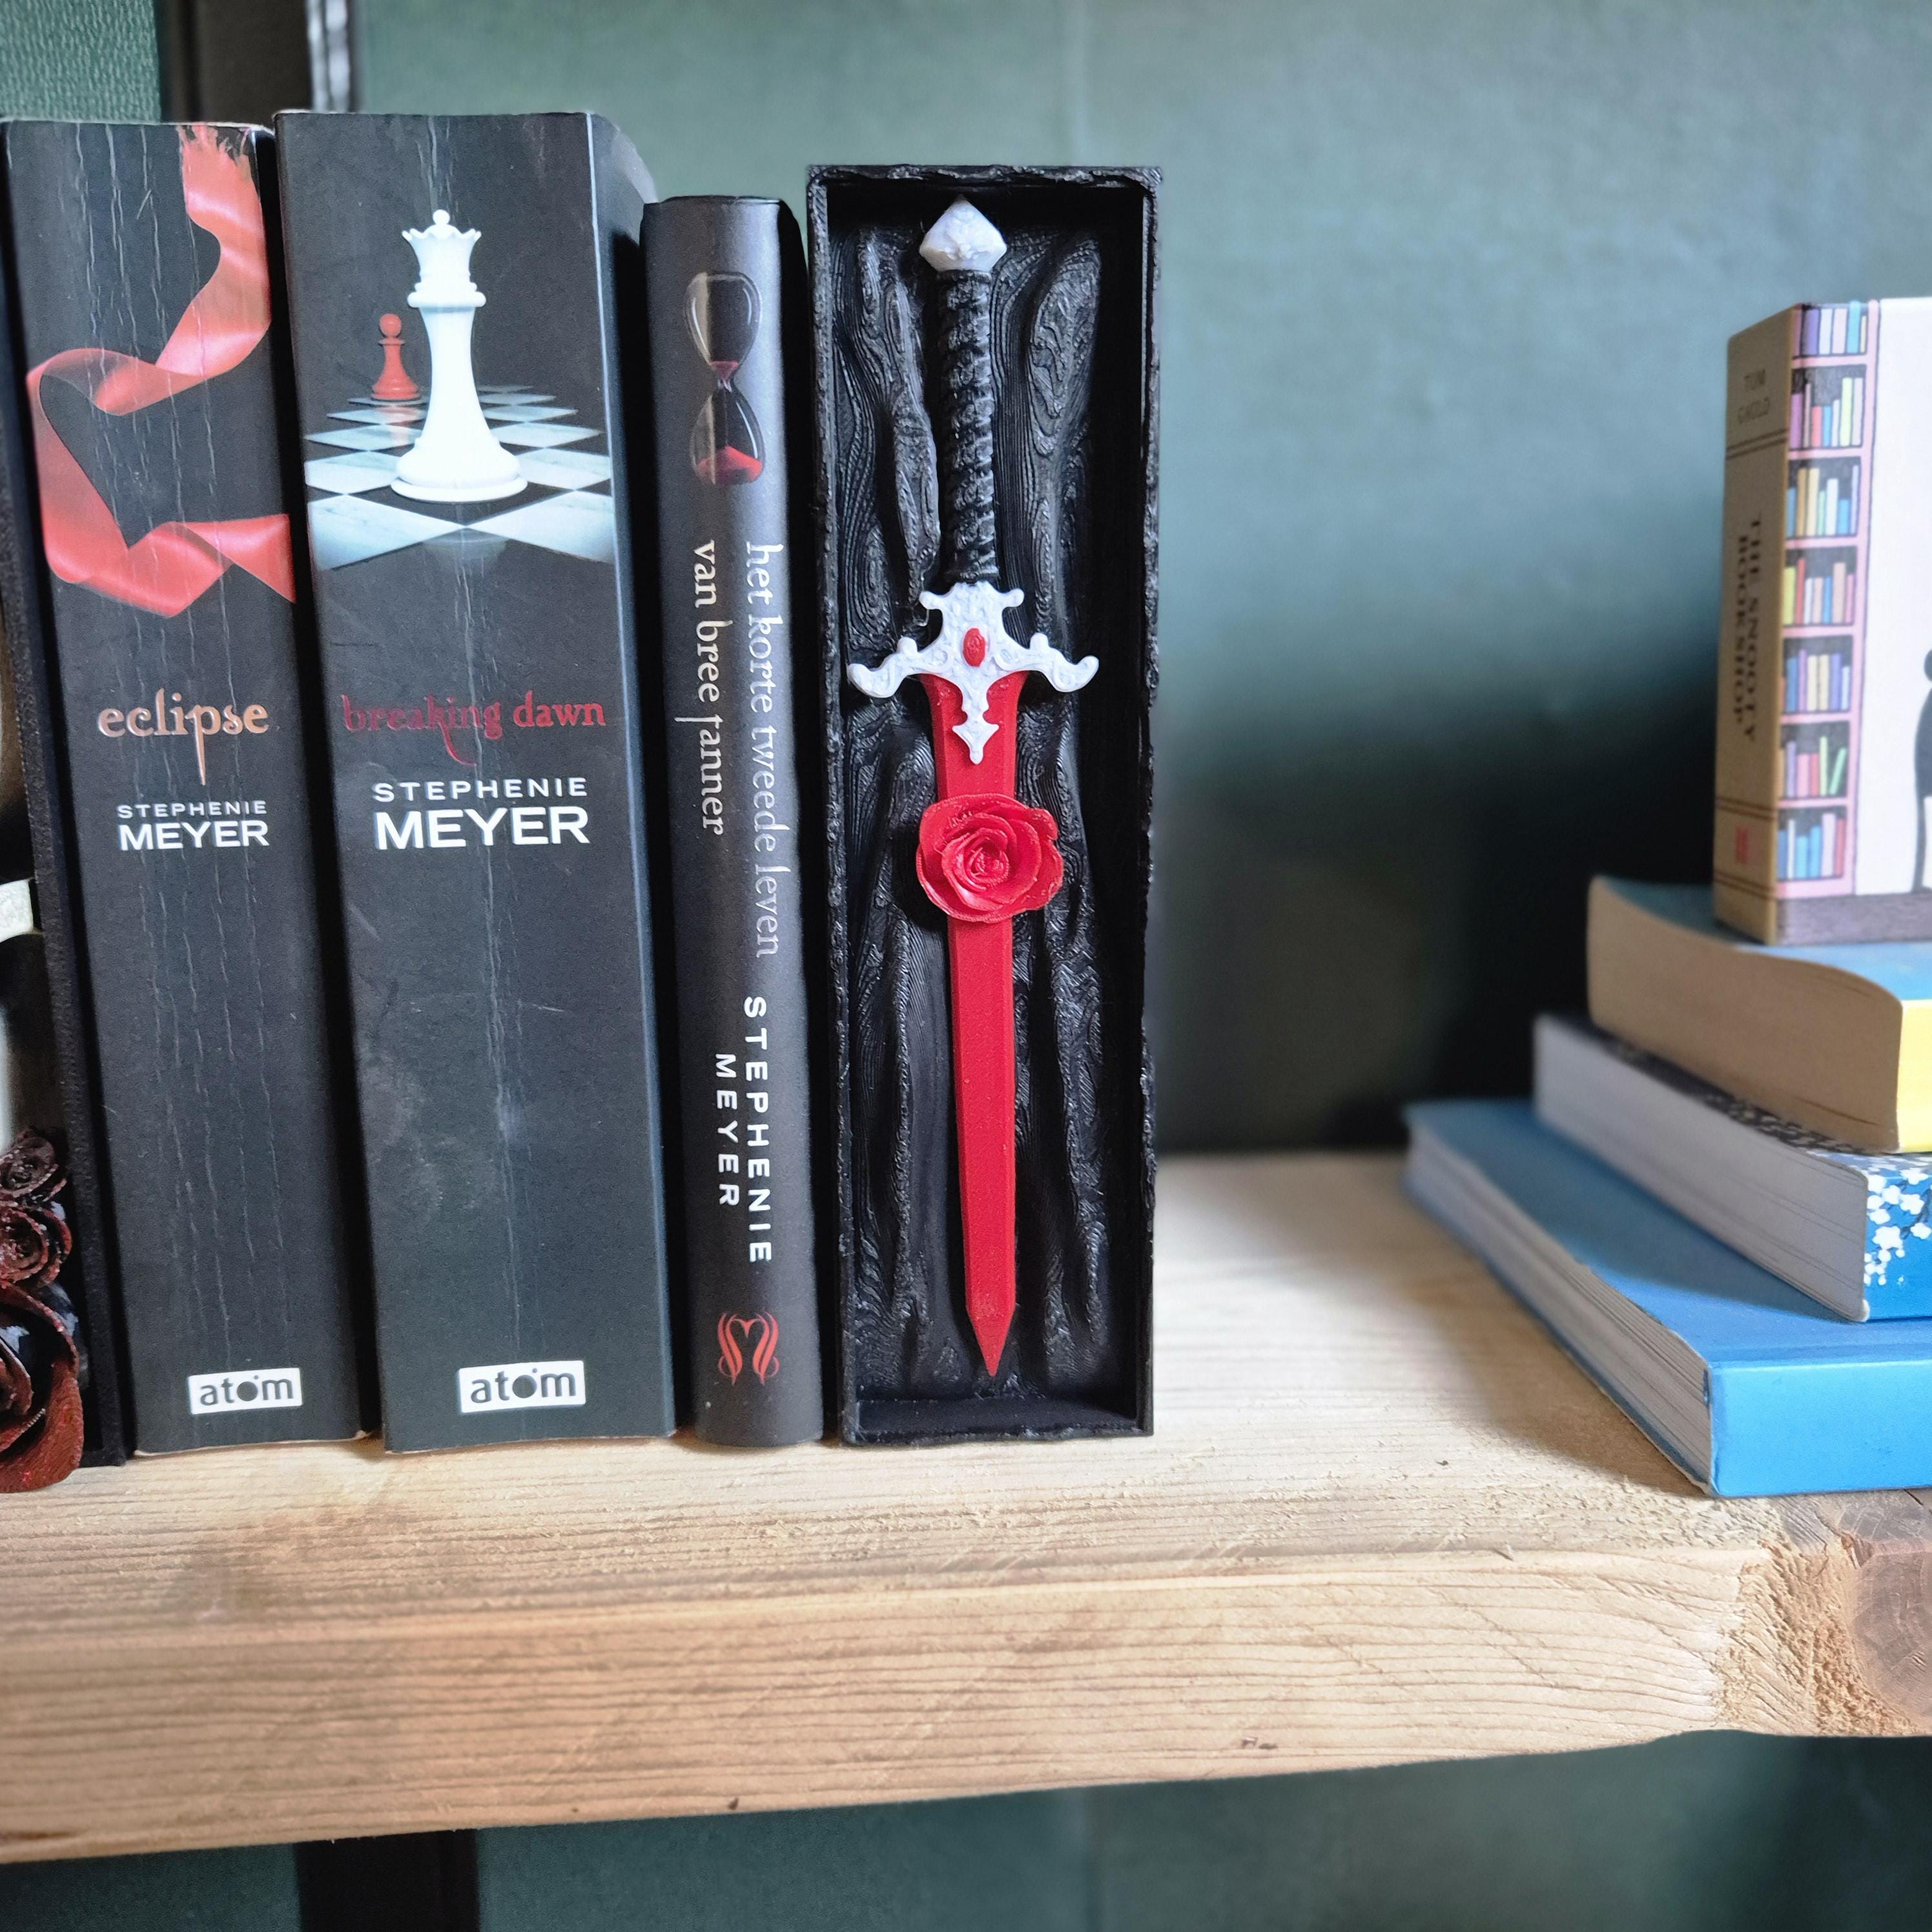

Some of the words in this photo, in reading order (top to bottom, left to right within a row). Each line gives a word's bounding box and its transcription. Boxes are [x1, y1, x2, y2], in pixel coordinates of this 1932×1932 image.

[694, 540, 715, 608] van
[745, 541, 783, 604] het
[696, 619, 734, 703] bree
[748, 613, 783, 713] korte
[1744, 598, 1758, 741] SNOOTY
[97, 687, 269, 786] eclipse
[341, 694, 504, 767] breaking
[513, 690, 607, 728] dawn
[117, 799, 267, 819] STEPHENIE
[371, 777, 588, 803] STEPHENIE
[674, 714, 724, 836] tanner
[750, 724, 790, 852] tweede
[118, 820, 270, 852] MEYER
[373, 806, 591, 850] MEYER
[754, 865, 791, 959] leven
[715, 1053, 741, 1207] MEYER
[744, 995, 772, 1263] STEPHENIE
[199, 1374, 294, 1406] atom
[469, 1367, 577, 1404] atom
